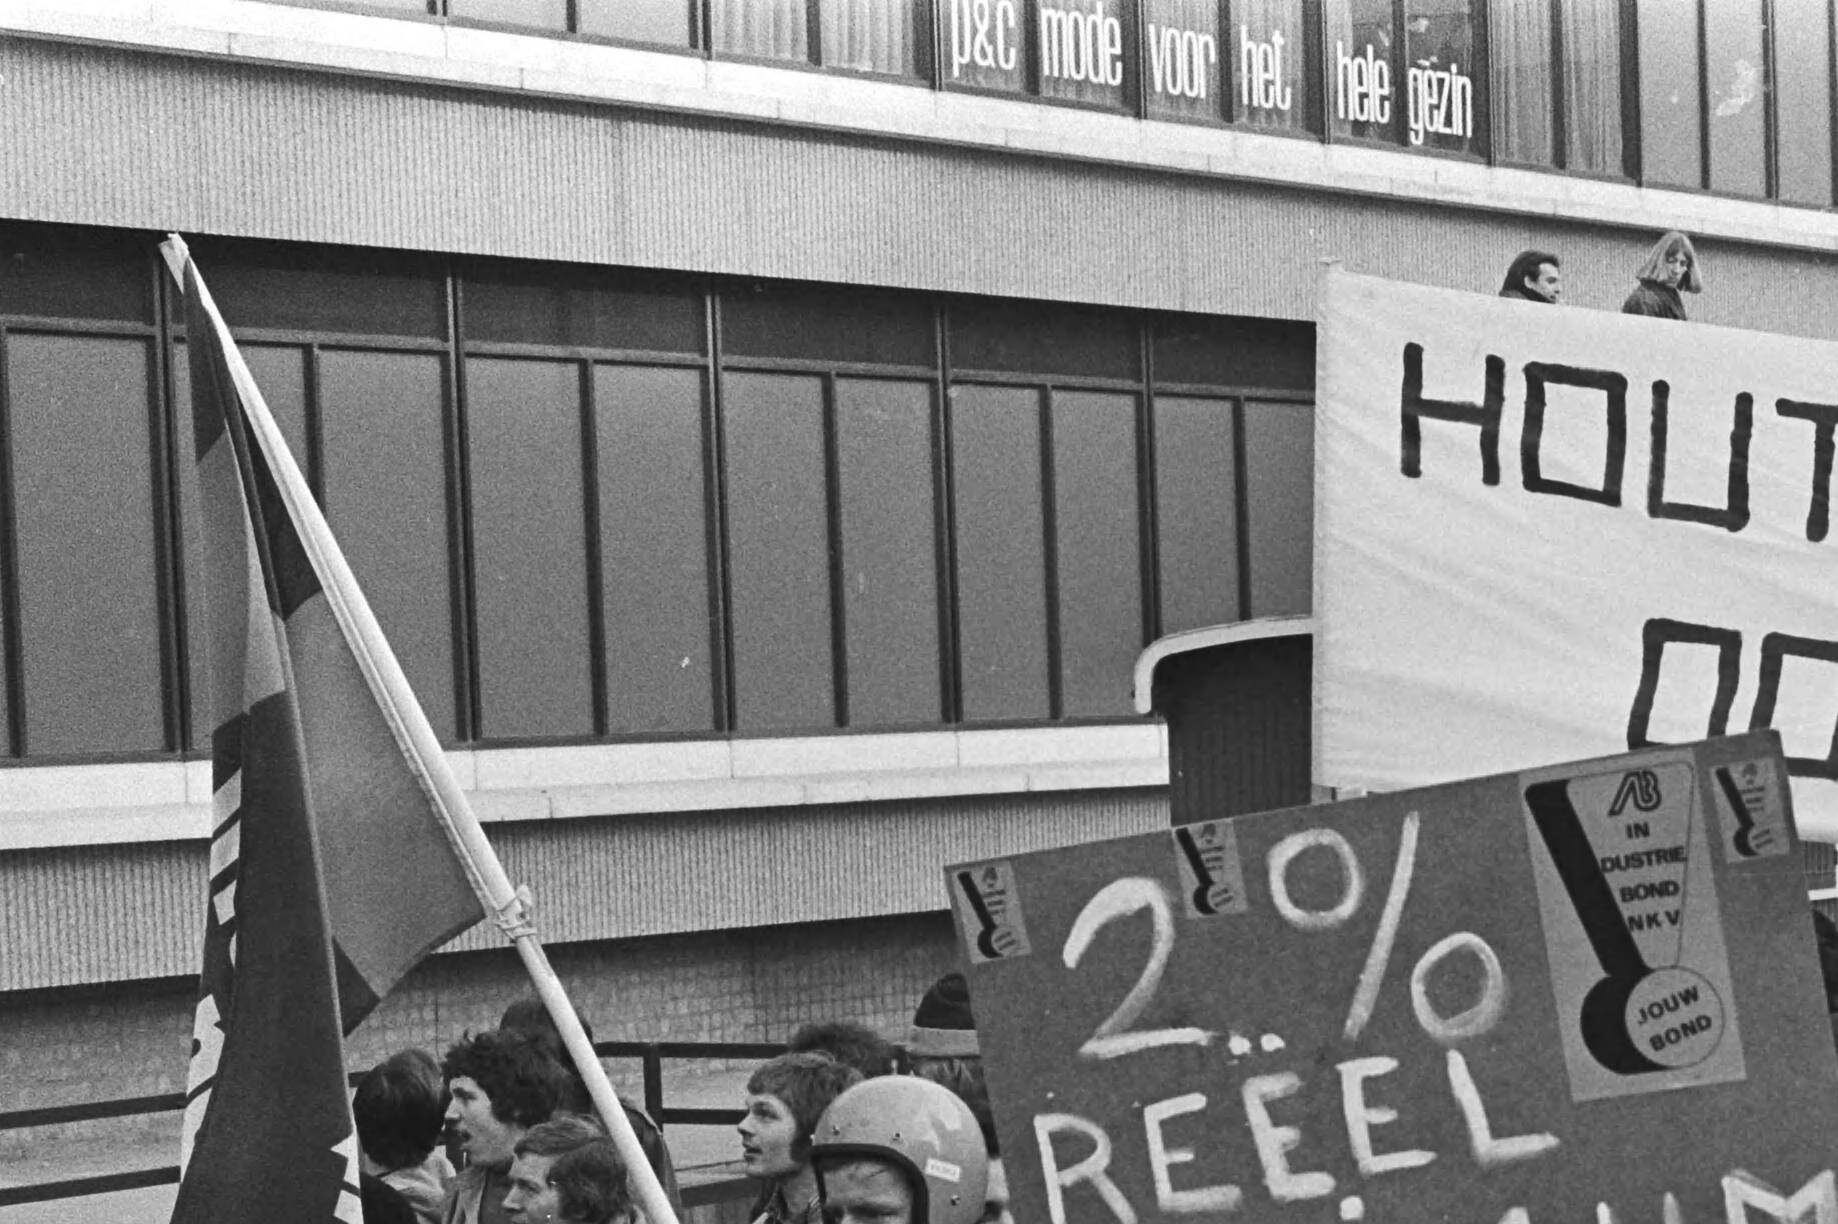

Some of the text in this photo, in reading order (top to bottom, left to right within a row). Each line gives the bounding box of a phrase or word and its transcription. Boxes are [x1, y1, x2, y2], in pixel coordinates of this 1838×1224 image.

[1040, 0, 1122, 86] mode
[1149, 23, 1216, 99] voor
[1240, 24, 1292, 111] het
[1336, 39, 1390, 124] hele
[1407, 62, 1472, 146] gezin
[1626, 822, 1651, 840] IN
[1600, 845, 1687, 873] DUSTRIE
[1620, 879, 1680, 902] BOND
[1638, 986, 1699, 1026] JOUW
[1649, 1013, 1713, 1053] BOND
